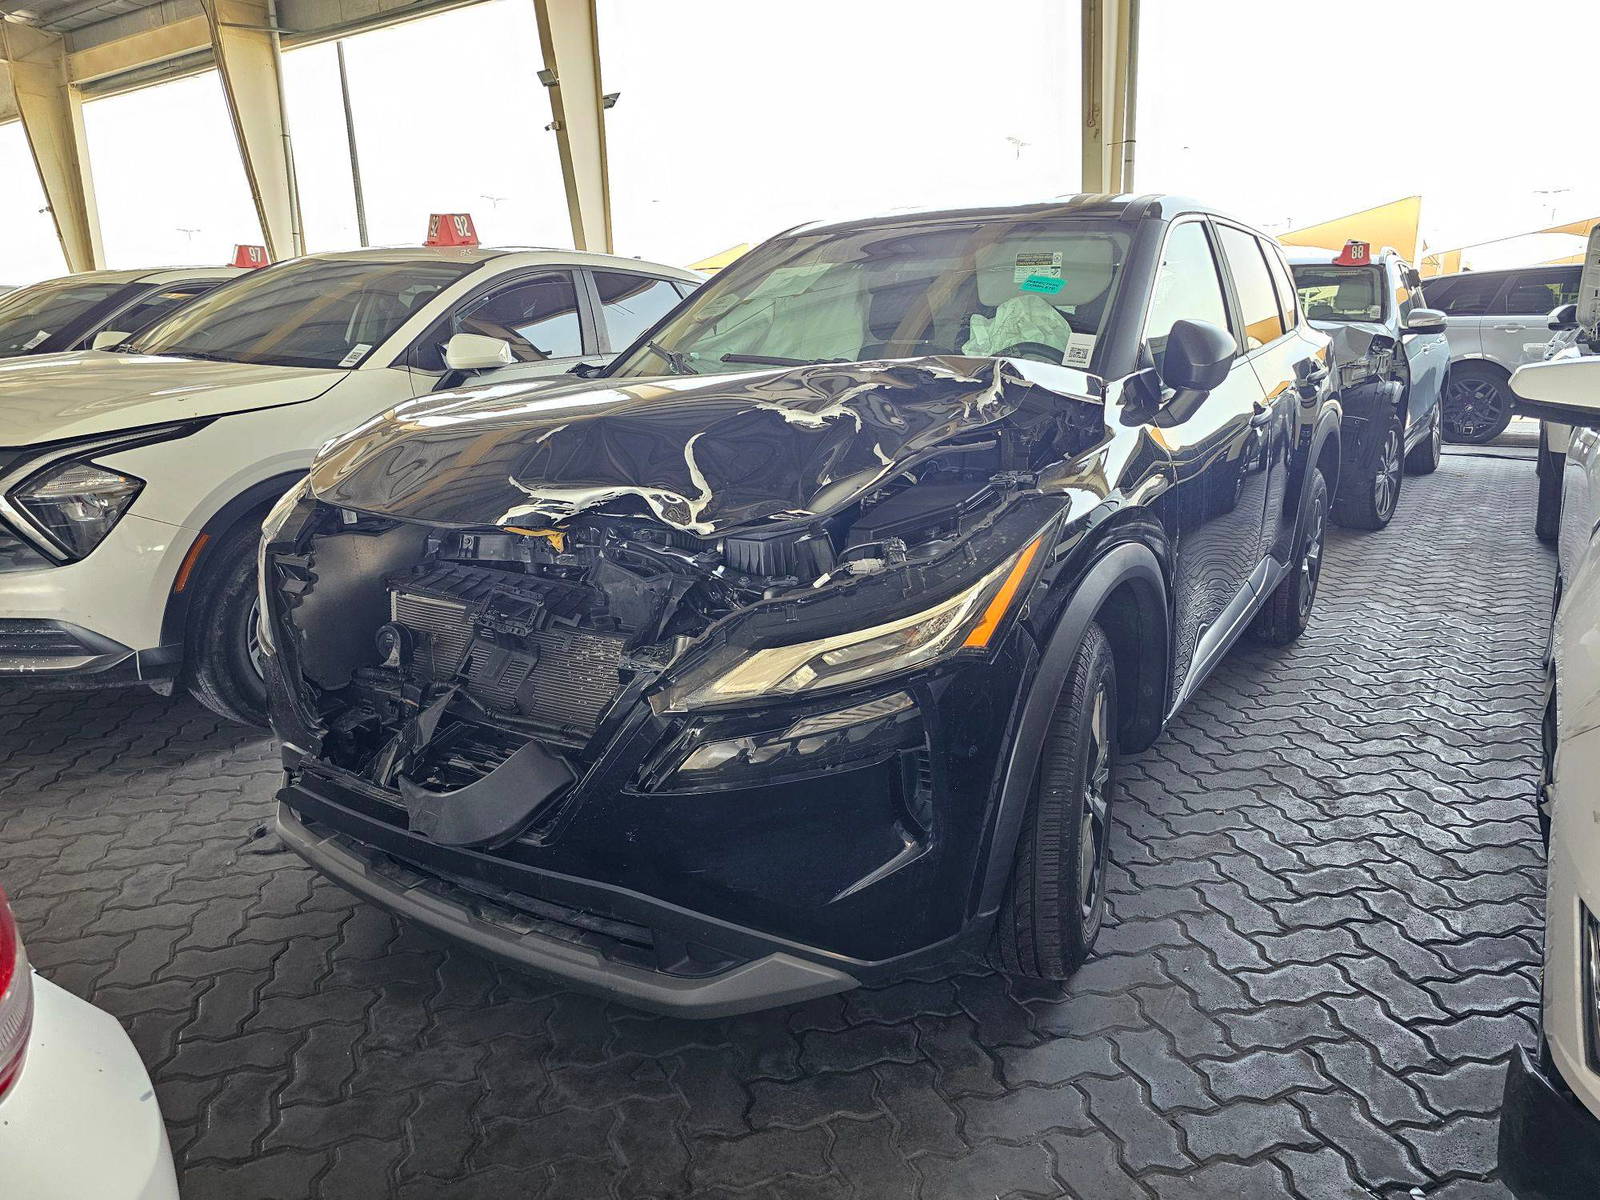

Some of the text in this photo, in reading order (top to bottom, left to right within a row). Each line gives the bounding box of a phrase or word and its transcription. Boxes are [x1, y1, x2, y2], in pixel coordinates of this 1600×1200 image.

[454, 216, 471, 237] 92
[248, 247, 261, 264] 97
[1351, 245, 1364, 259] 88
